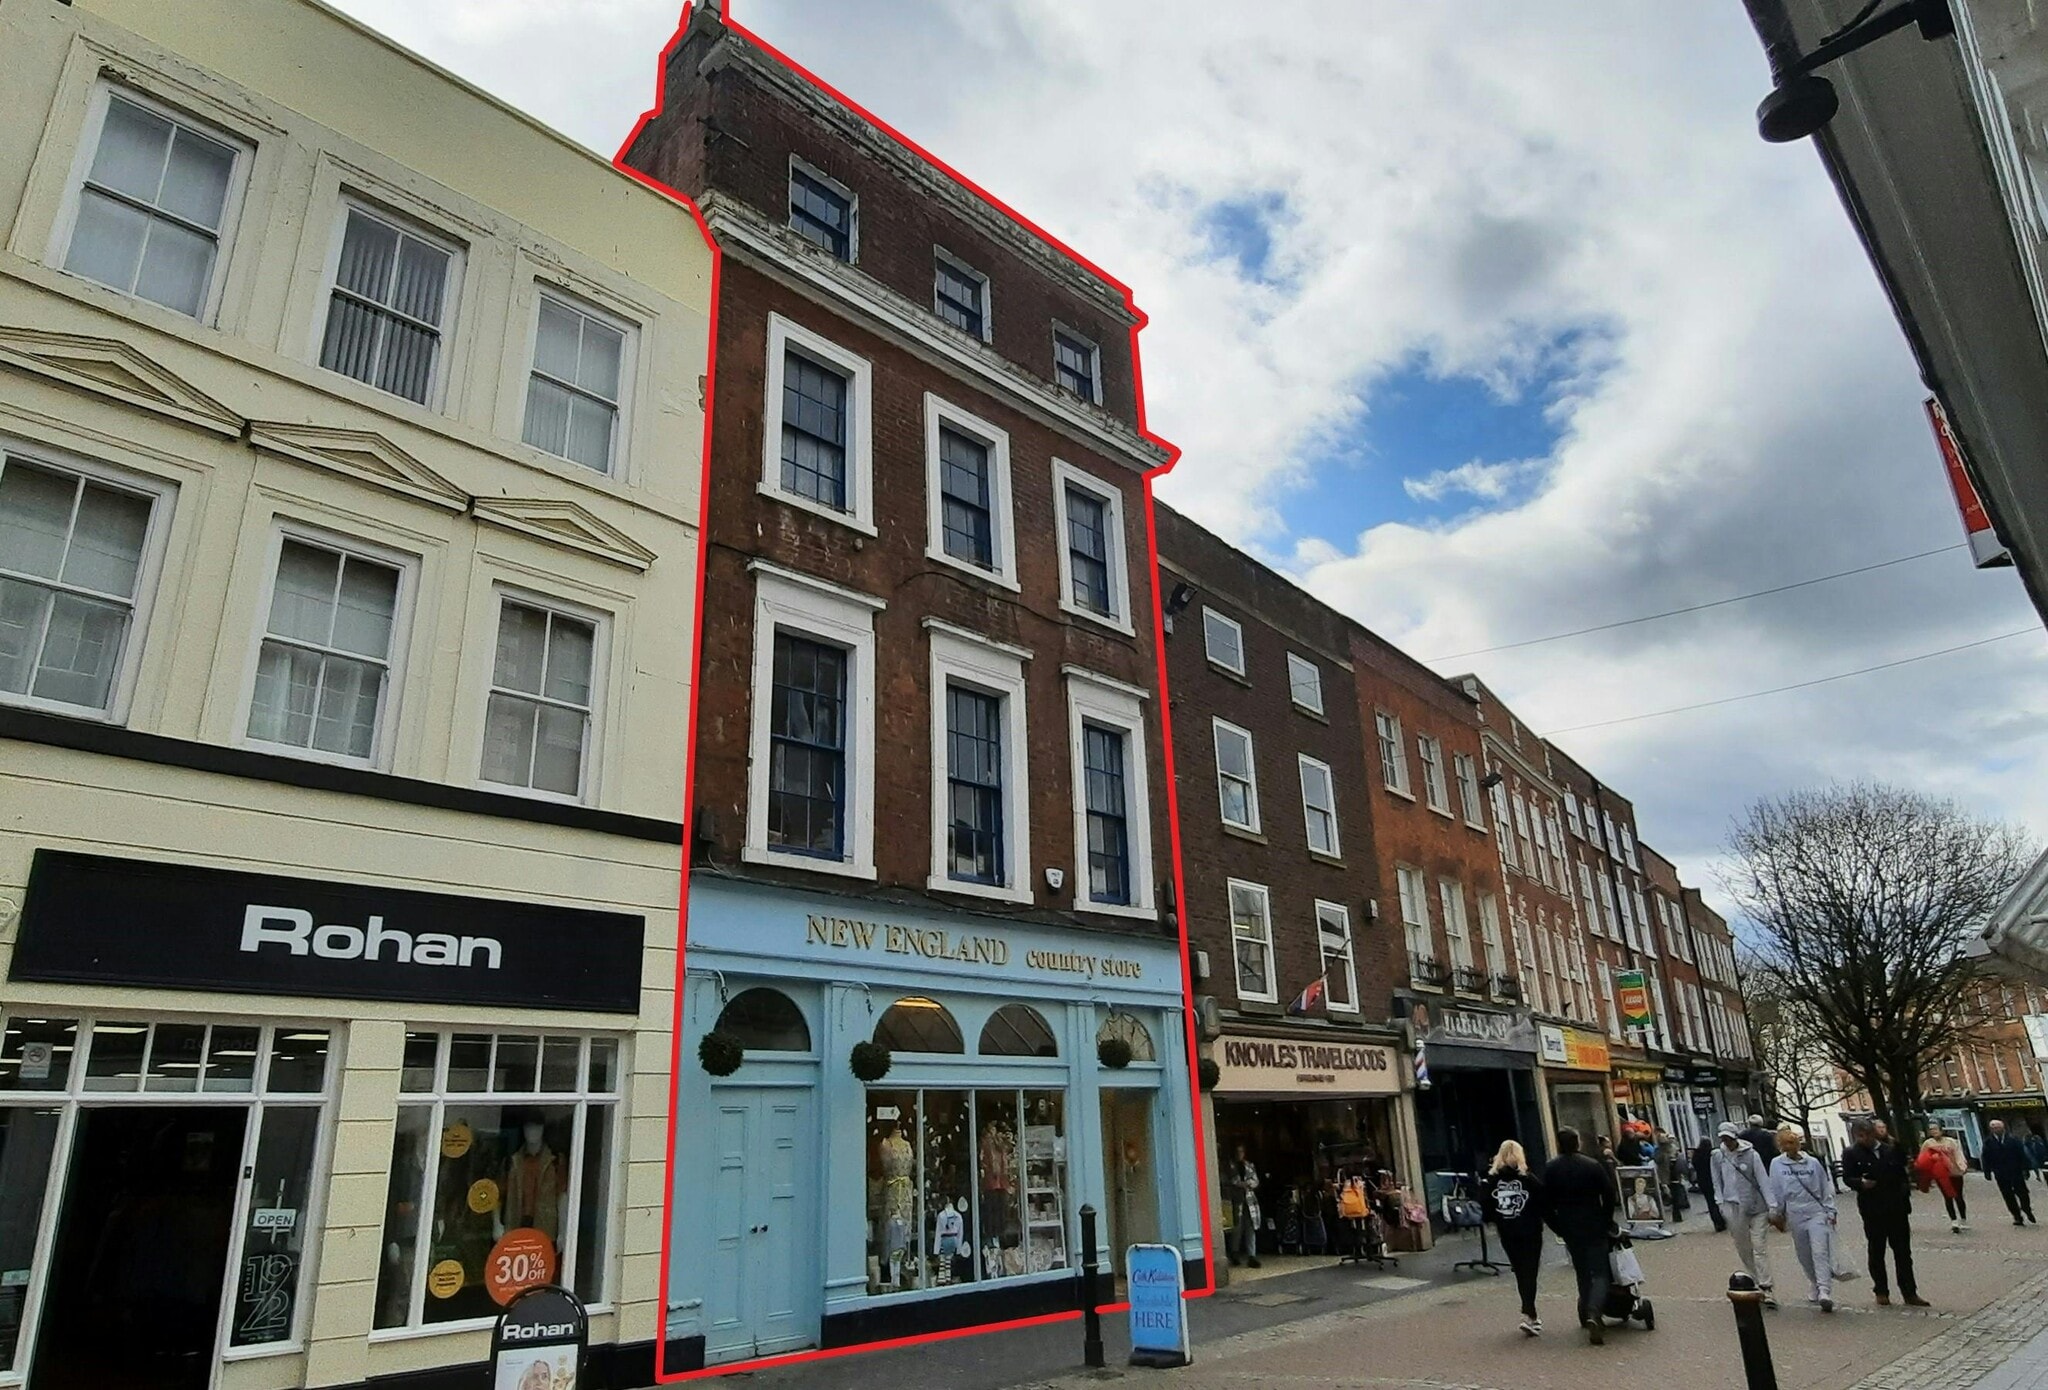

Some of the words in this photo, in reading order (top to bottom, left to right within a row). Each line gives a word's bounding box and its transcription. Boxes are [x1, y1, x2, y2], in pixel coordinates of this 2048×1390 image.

[239, 904, 502, 969] Rohan
[806, 914, 877, 949] NEW
[884, 924, 1009, 965] ENGLAND
[1026, 949, 1097, 979] country
[1101, 953, 1141, 978] store
[1225, 1041, 1297, 1068] KNOWLES
[257, 1215, 292, 1225] OPEN
[494, 1252, 545, 1284] 30%
[502, 1322, 575, 1340] Rohan
[1134, 1311, 1173, 1329] HERE
